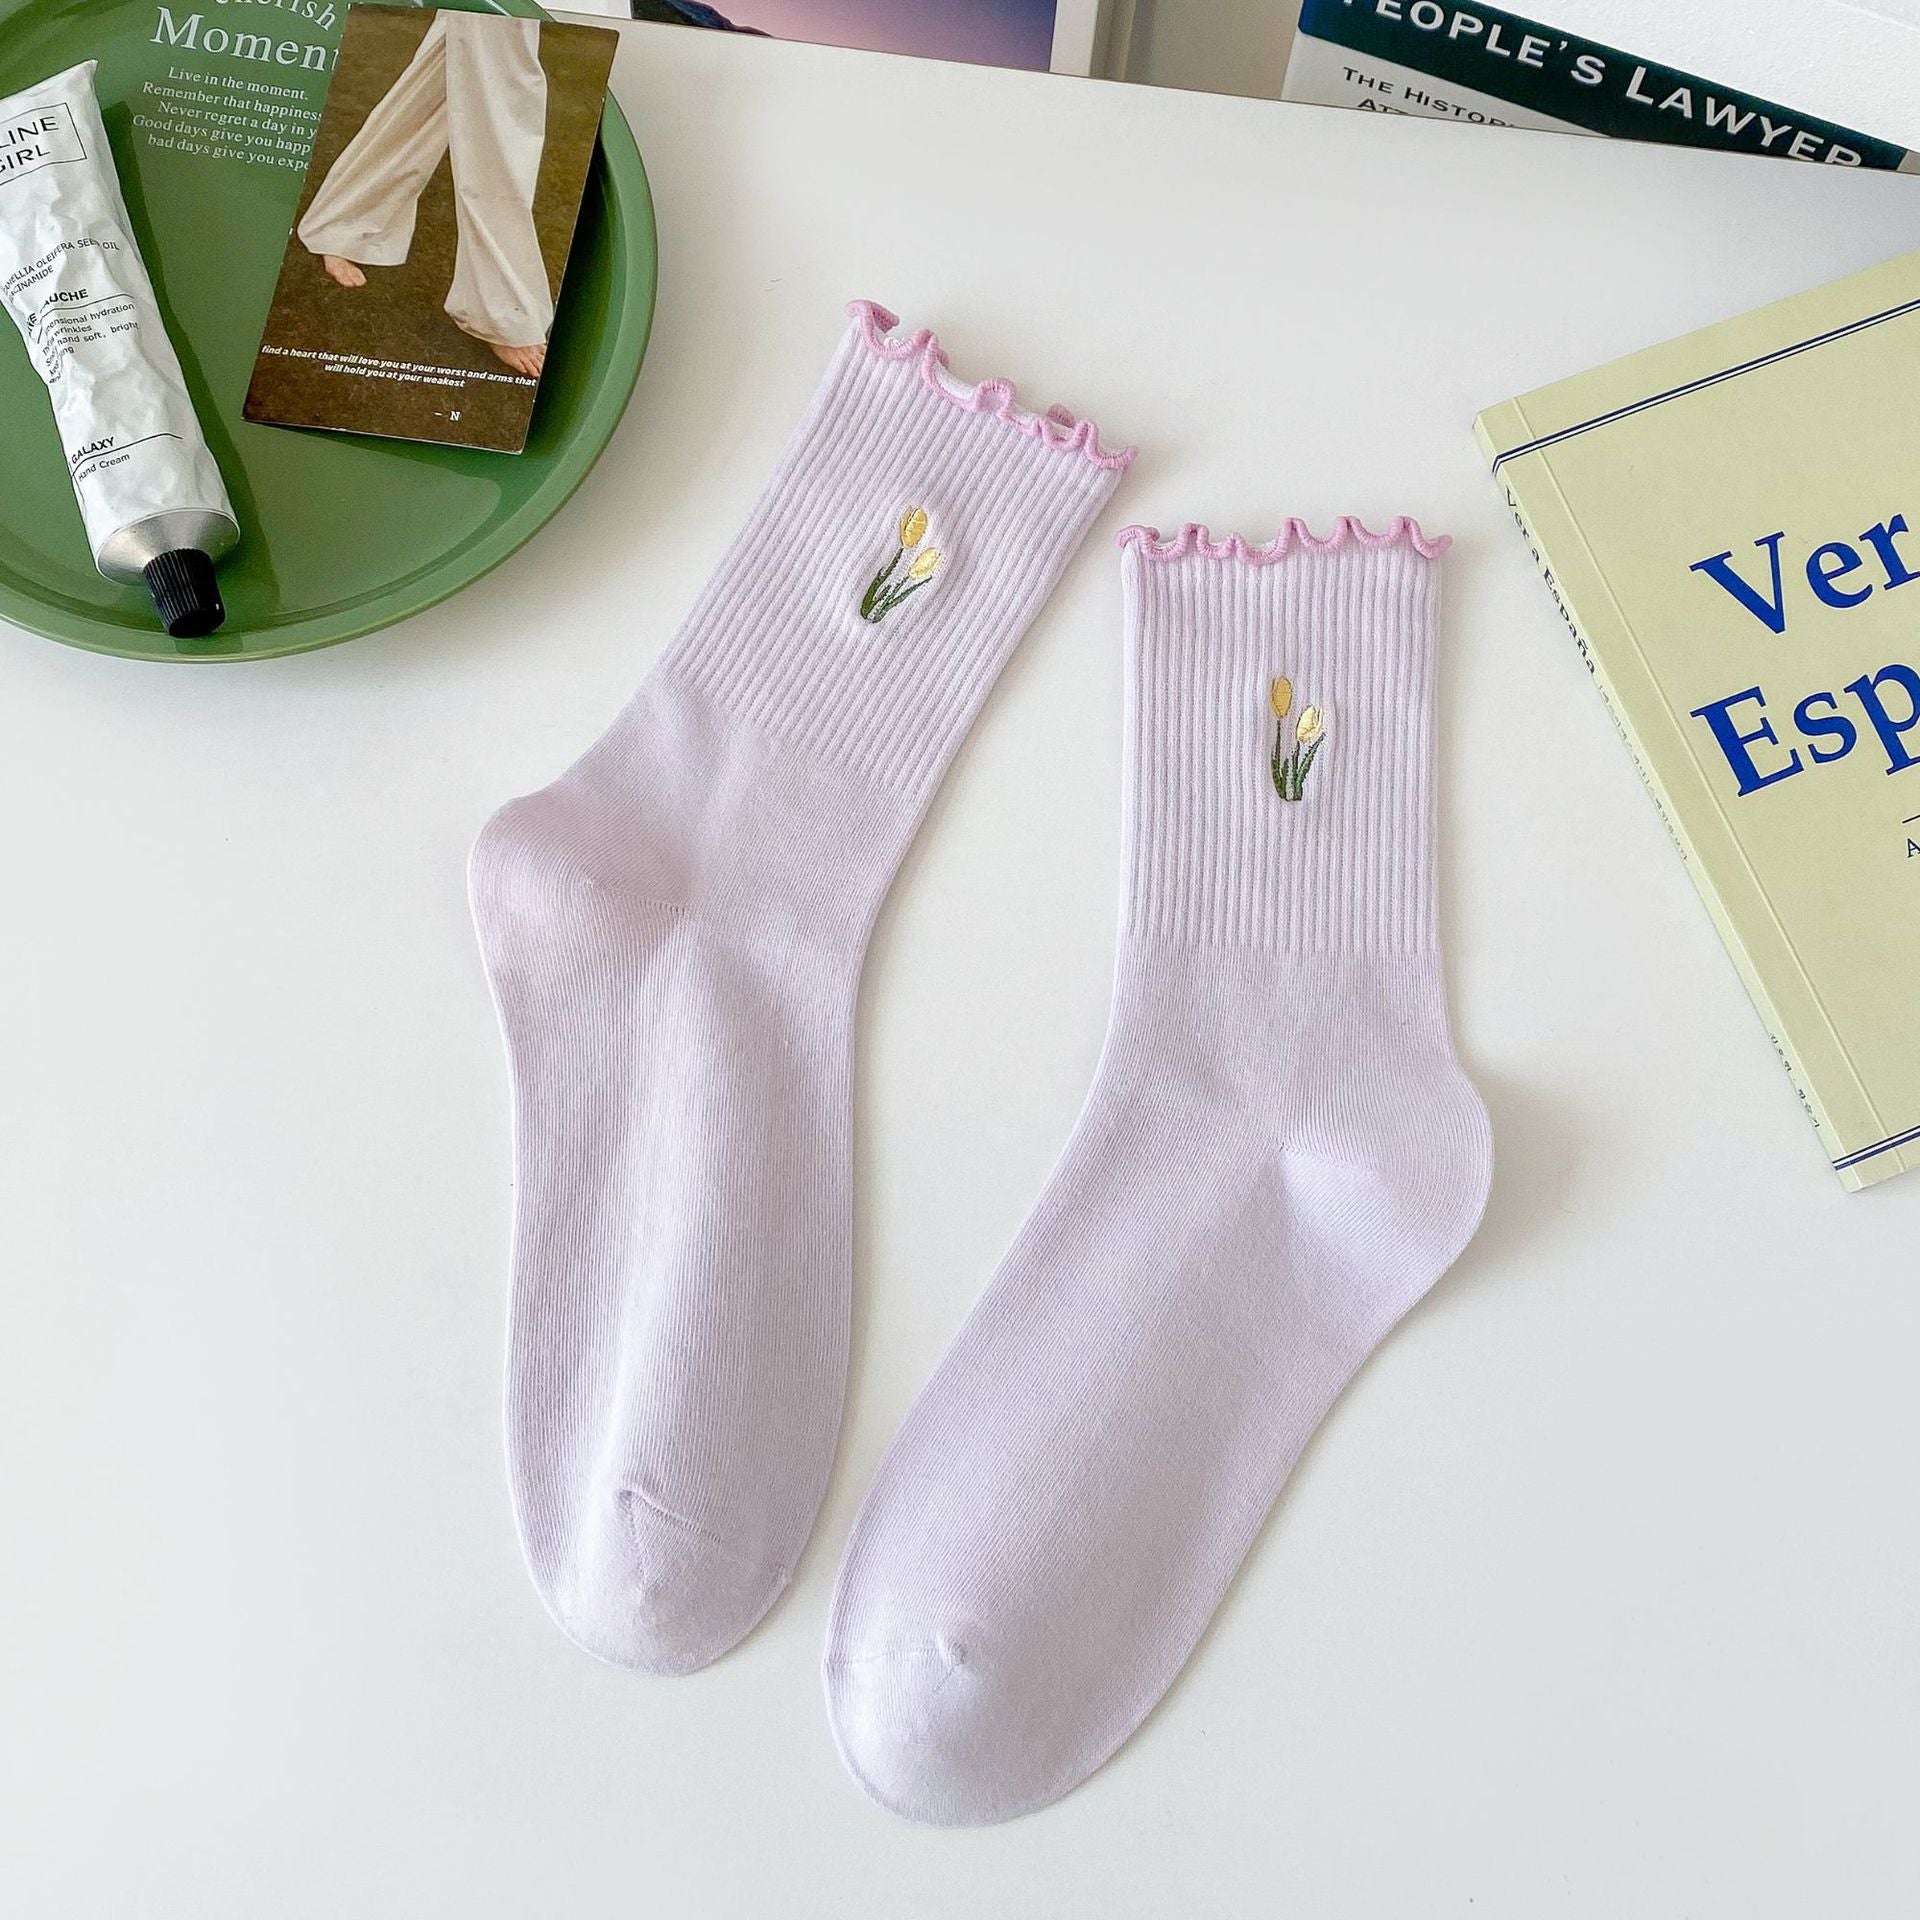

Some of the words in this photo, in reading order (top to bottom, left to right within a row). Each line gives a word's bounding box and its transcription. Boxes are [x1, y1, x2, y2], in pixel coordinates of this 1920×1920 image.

[1343, 0, 1606, 86] EOPLE'S
[142, 81, 221, 104] Remember
[223, 96, 250, 110] that
[168, 66, 201, 82] Live
[205, 72, 218, 85] in
[221, 76, 244, 90] the
[246, 82, 309, 100] moment.
[132, 114, 172, 131] Good
[175, 121, 208, 137] days
[210, 127, 243, 142] give
[245, 135, 273, 147] you
[157, 101, 202, 119] Never
[204, 111, 248, 126] regret
[250, 118, 258, 128] a
[261, 116, 288, 135] day
[291, 121, 305, 136] in
[147, 134, 174, 149] bad
[176, 138, 210, 156] days
[212, 145, 245, 160] give
[247, 152, 275, 165] you
[36, 242, 75, 269] OLEIFERA
[102, 241, 120, 251] OIL
[89, 303, 135, 320] hydration
[261, 345, 281, 355] find
[289, 348, 317, 359] heart
[317, 351, 339, 361] that
[339, 354, 358, 364] will
[358, 355, 380, 366] love
[379, 360, 400, 369] you
[400, 362, 412, 370] at
[411, 363, 436, 372] your
[437, 366, 467, 377] worst
[466, 370, 487, 380] and
[487, 374, 514, 383] arms
[514, 376, 537, 387] that
[324, 363, 343, 373] will
[343, 364, 367, 376] hold
[366, 368, 386, 379] you
[386, 371, 398, 380] at
[398, 373, 421, 382] your
[423, 375, 466, 388] weakest
[449, 410, 461, 422] N
[71, 436, 114, 464] GALAXY
[99, 453, 131, 469] Cream
[1689, 514, 1920, 634] Ver
[1690, 663, 1920, 797] Esp
